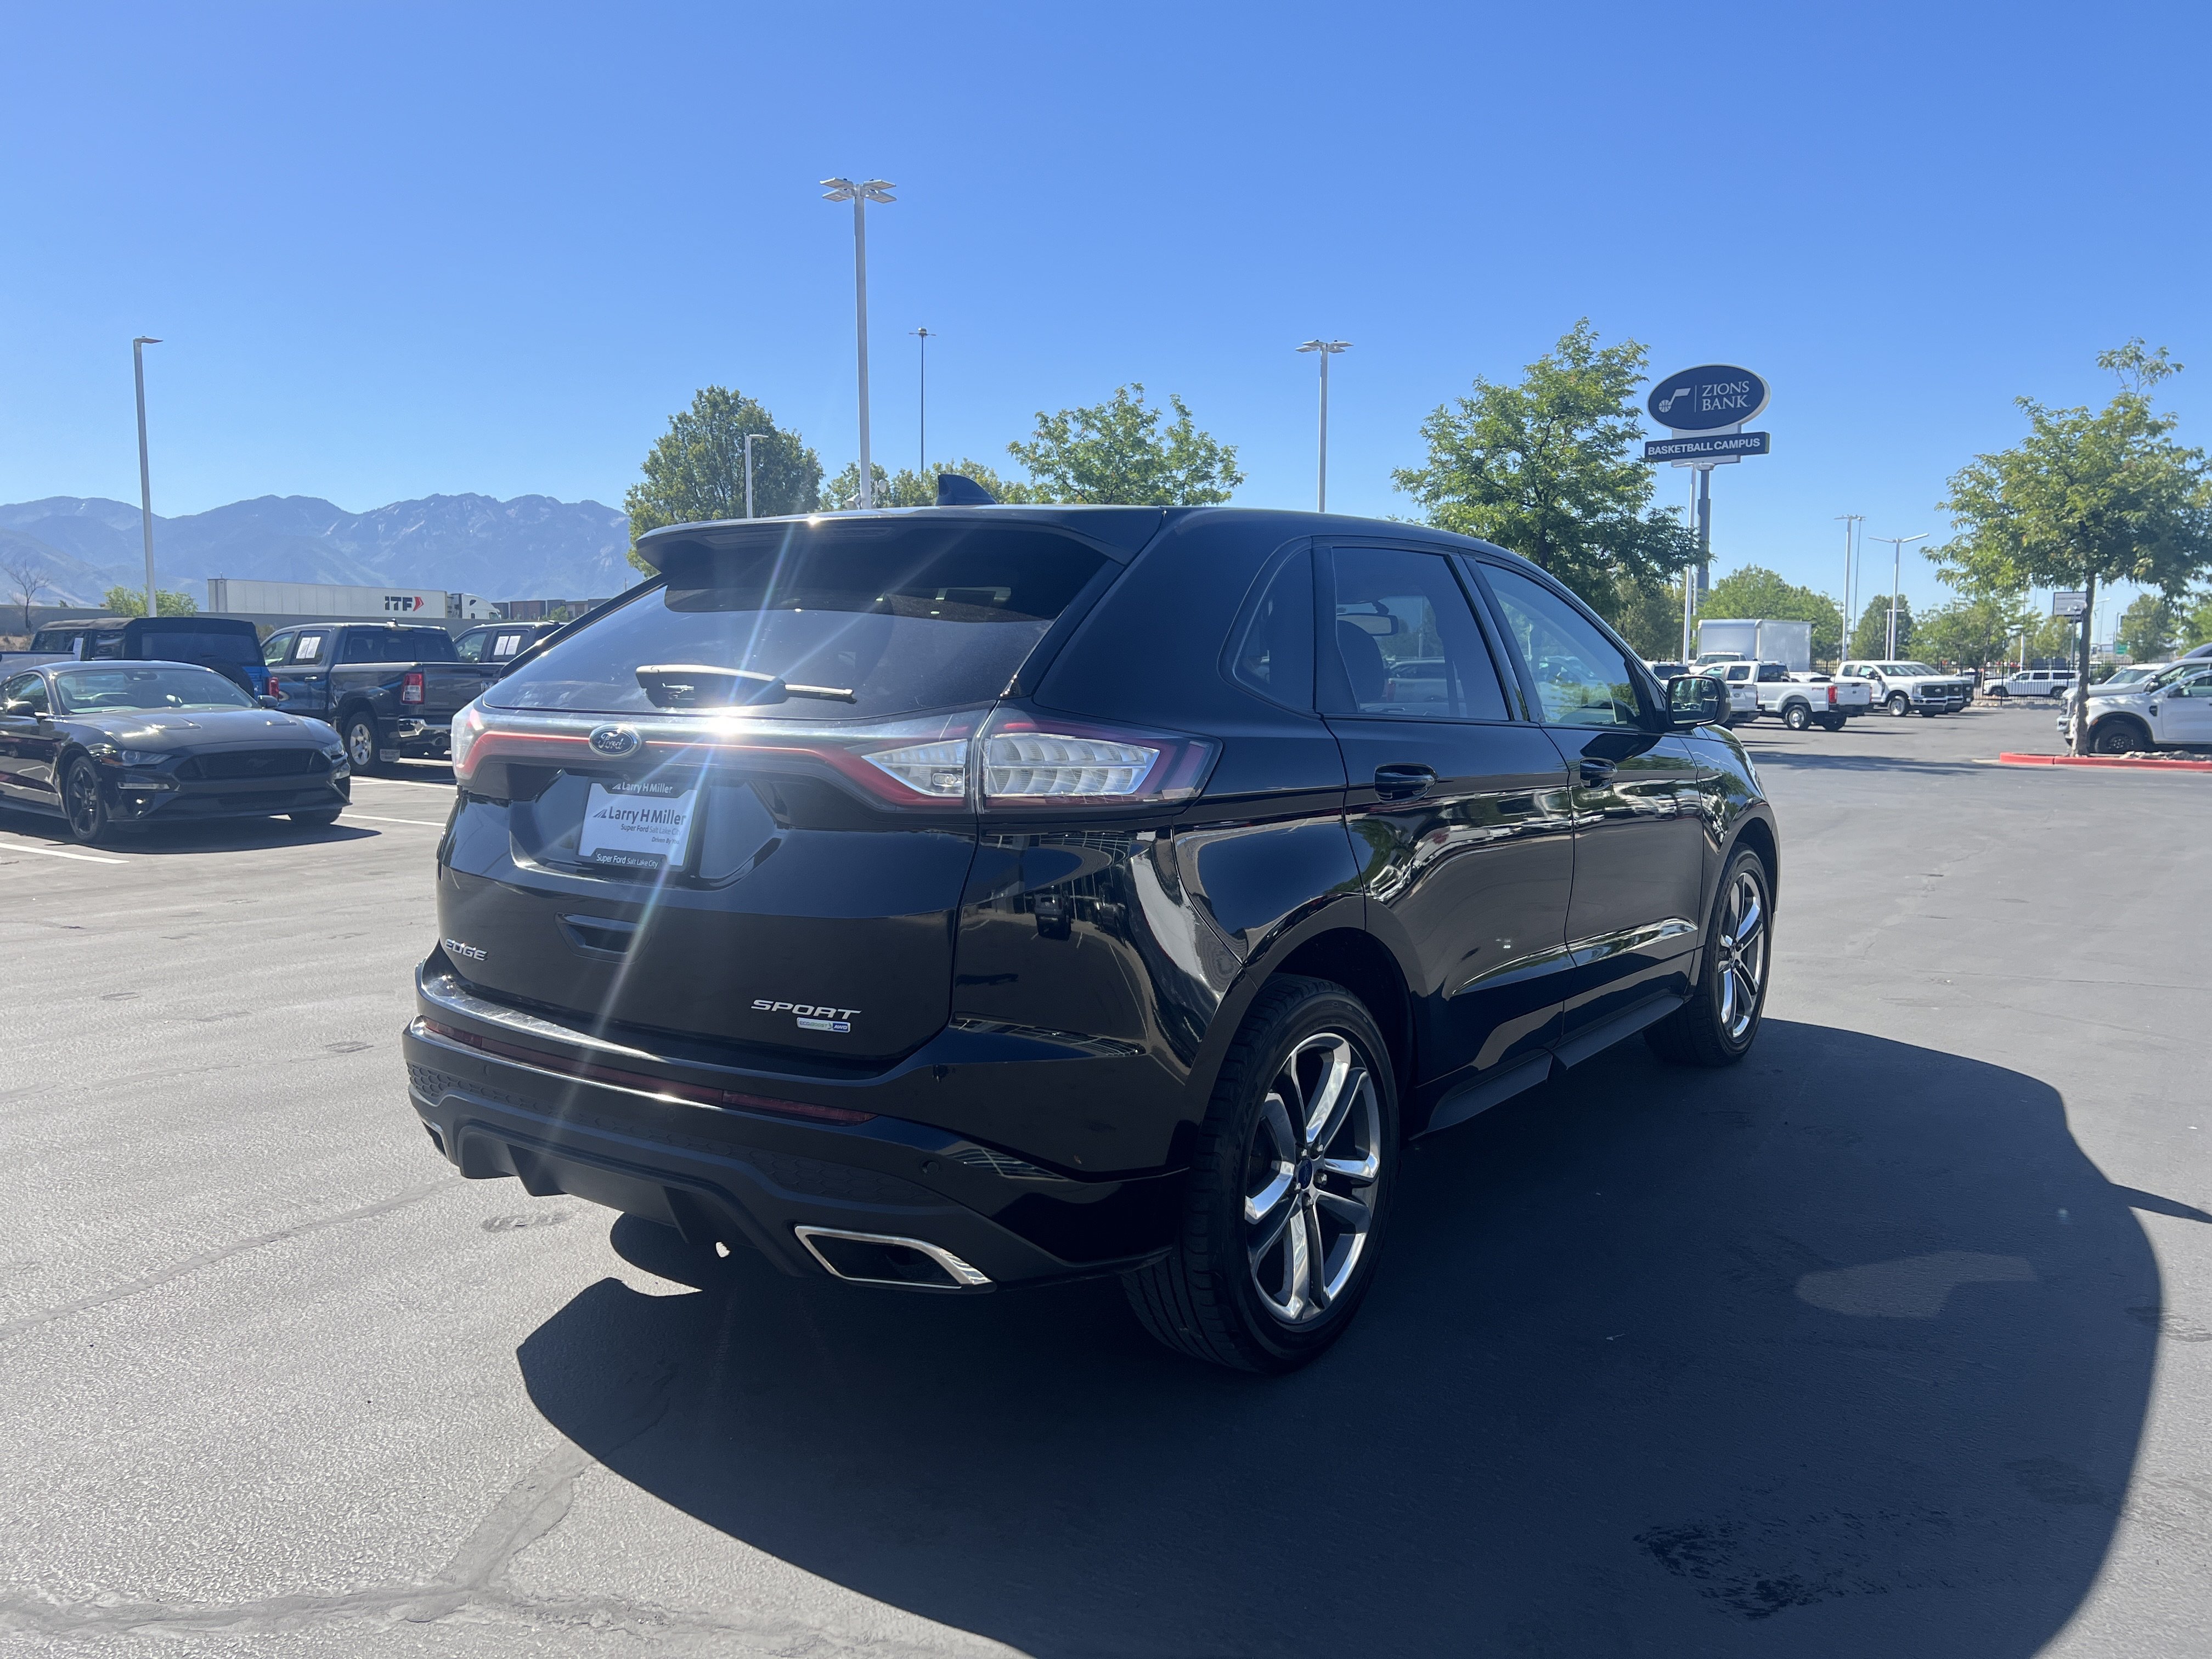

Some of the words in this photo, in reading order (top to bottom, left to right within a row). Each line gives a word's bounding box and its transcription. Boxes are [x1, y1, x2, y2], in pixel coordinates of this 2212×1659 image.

[1702, 380, 1750, 397] ZIONS
[1701, 394, 1748, 411] BANK
[1647, 442, 1713, 455] BASKETBALL
[1713, 438, 1760, 451] CAMPUS
[597, 732, 624, 749] Ford
[622, 781, 642, 793] Larry
[642, 783, 649, 792] H
[650, 783, 673, 793] Miller
[608, 806, 639, 825] Larry
[640, 809, 650, 822] H
[651, 809, 686, 825] Miller
[620, 823, 636, 832] Super
[596, 854, 613, 864] Super
[613, 855, 627, 864] Ford
[648, 860, 659, 869] City
[445, 938, 488, 961] EDGE
[751, 999, 862, 1020] SPORT
